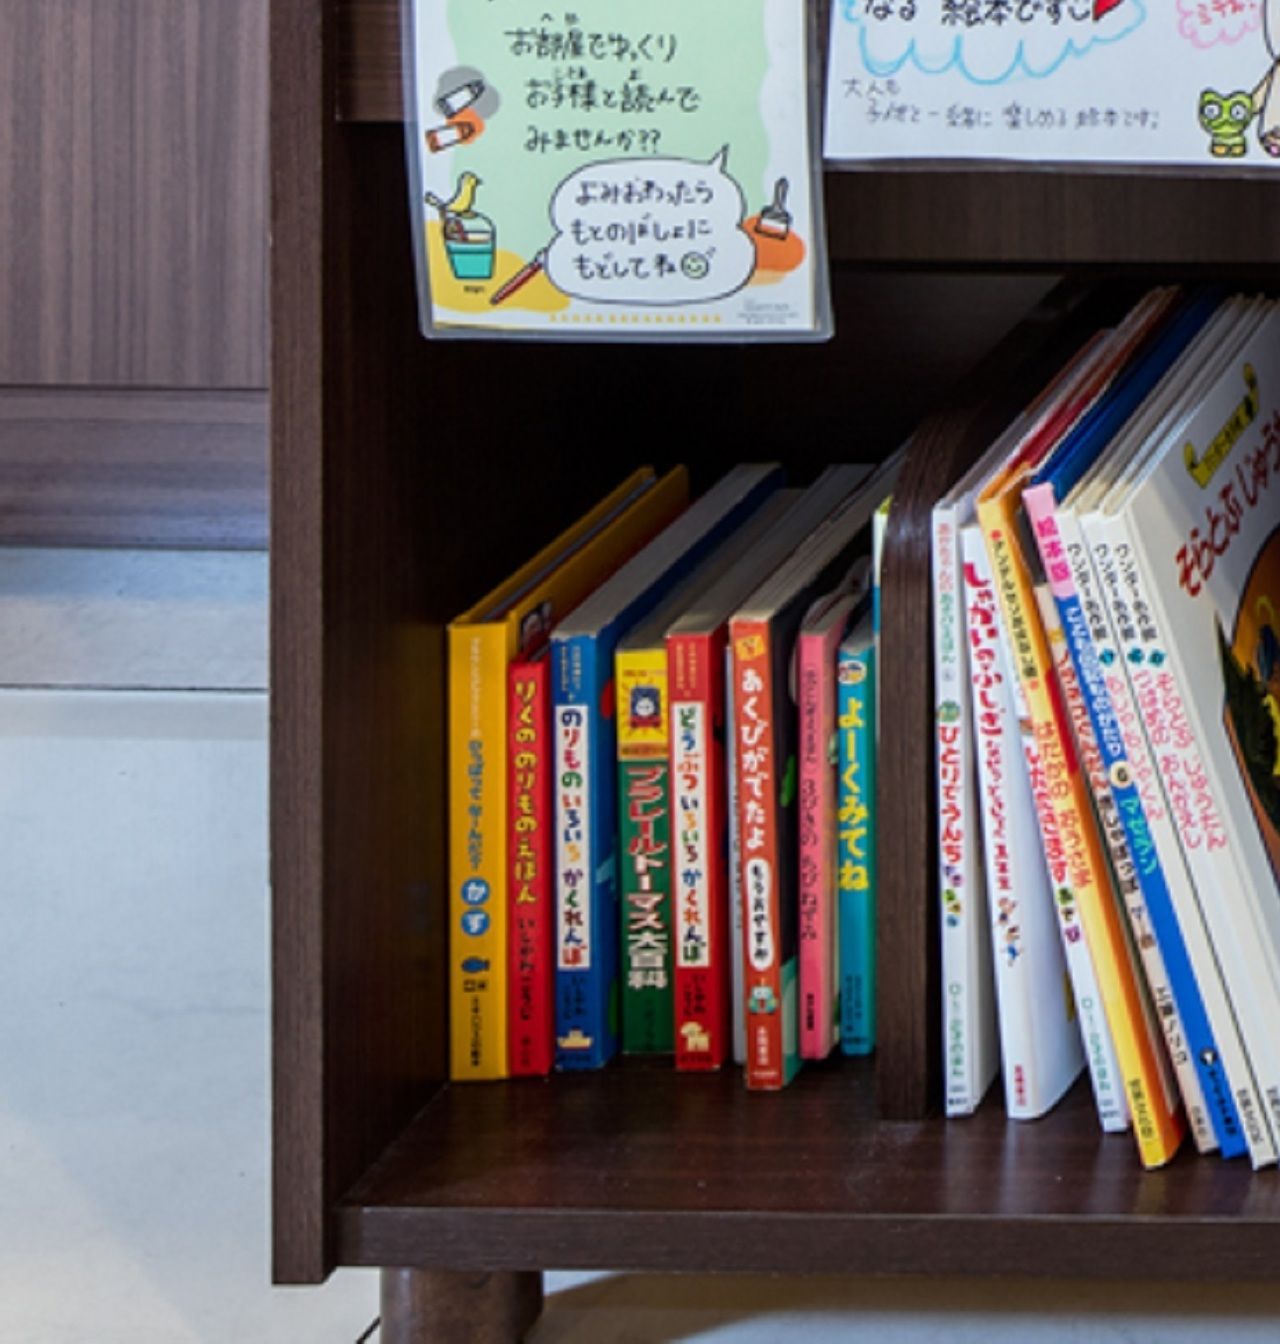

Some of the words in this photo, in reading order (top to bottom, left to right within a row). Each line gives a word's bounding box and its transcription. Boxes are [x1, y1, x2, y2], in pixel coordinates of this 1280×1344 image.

[838, 696, 869, 892] よーくみてね
